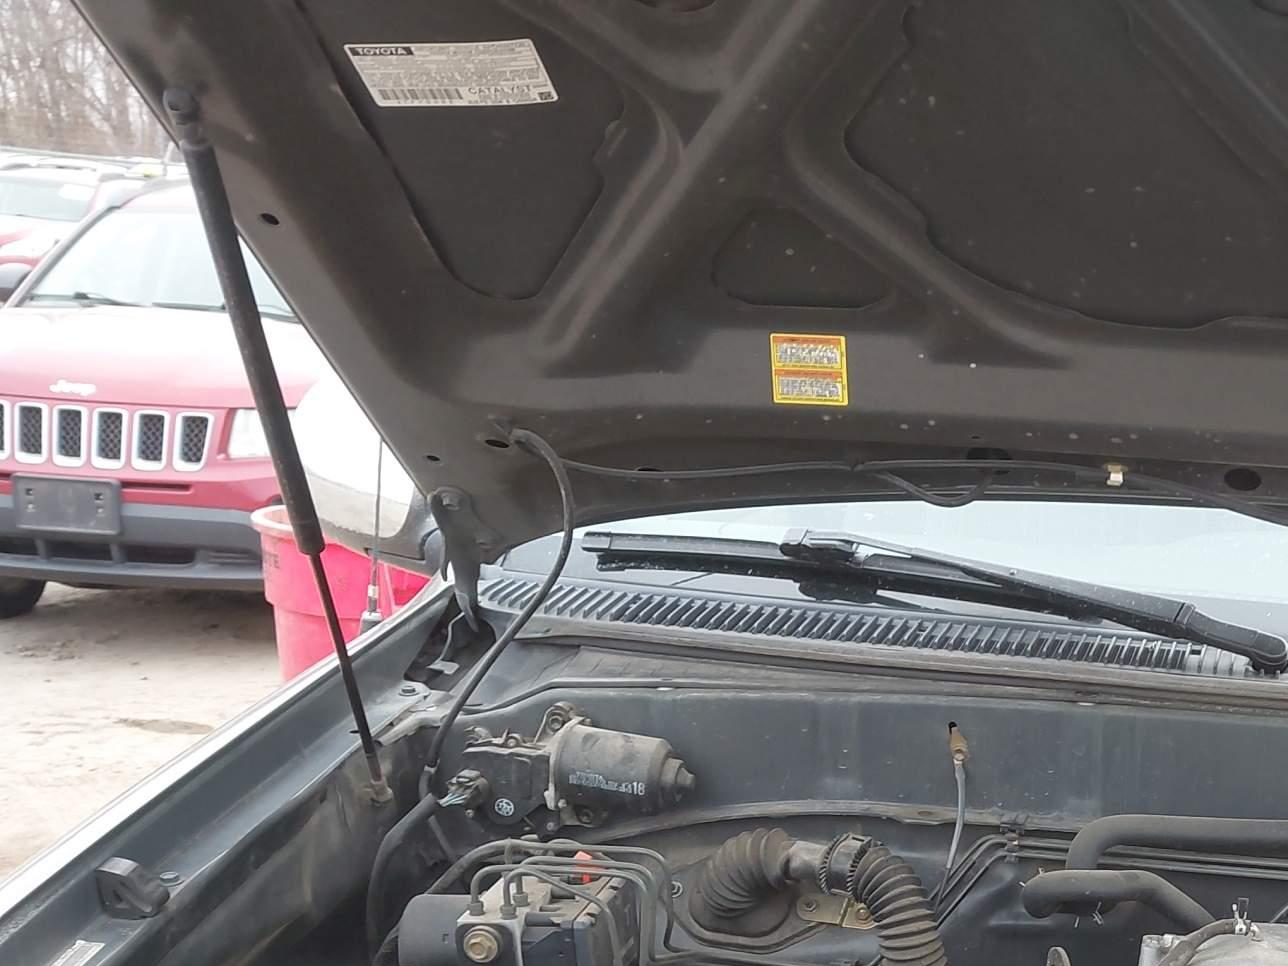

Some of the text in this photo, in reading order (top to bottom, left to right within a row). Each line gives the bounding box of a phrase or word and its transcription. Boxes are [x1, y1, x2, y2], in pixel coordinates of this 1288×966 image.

[355, 47, 407, 55] TOYOTA
[468, 84, 531, 95] CATALYST
[49, 379, 97, 396] Jeep
